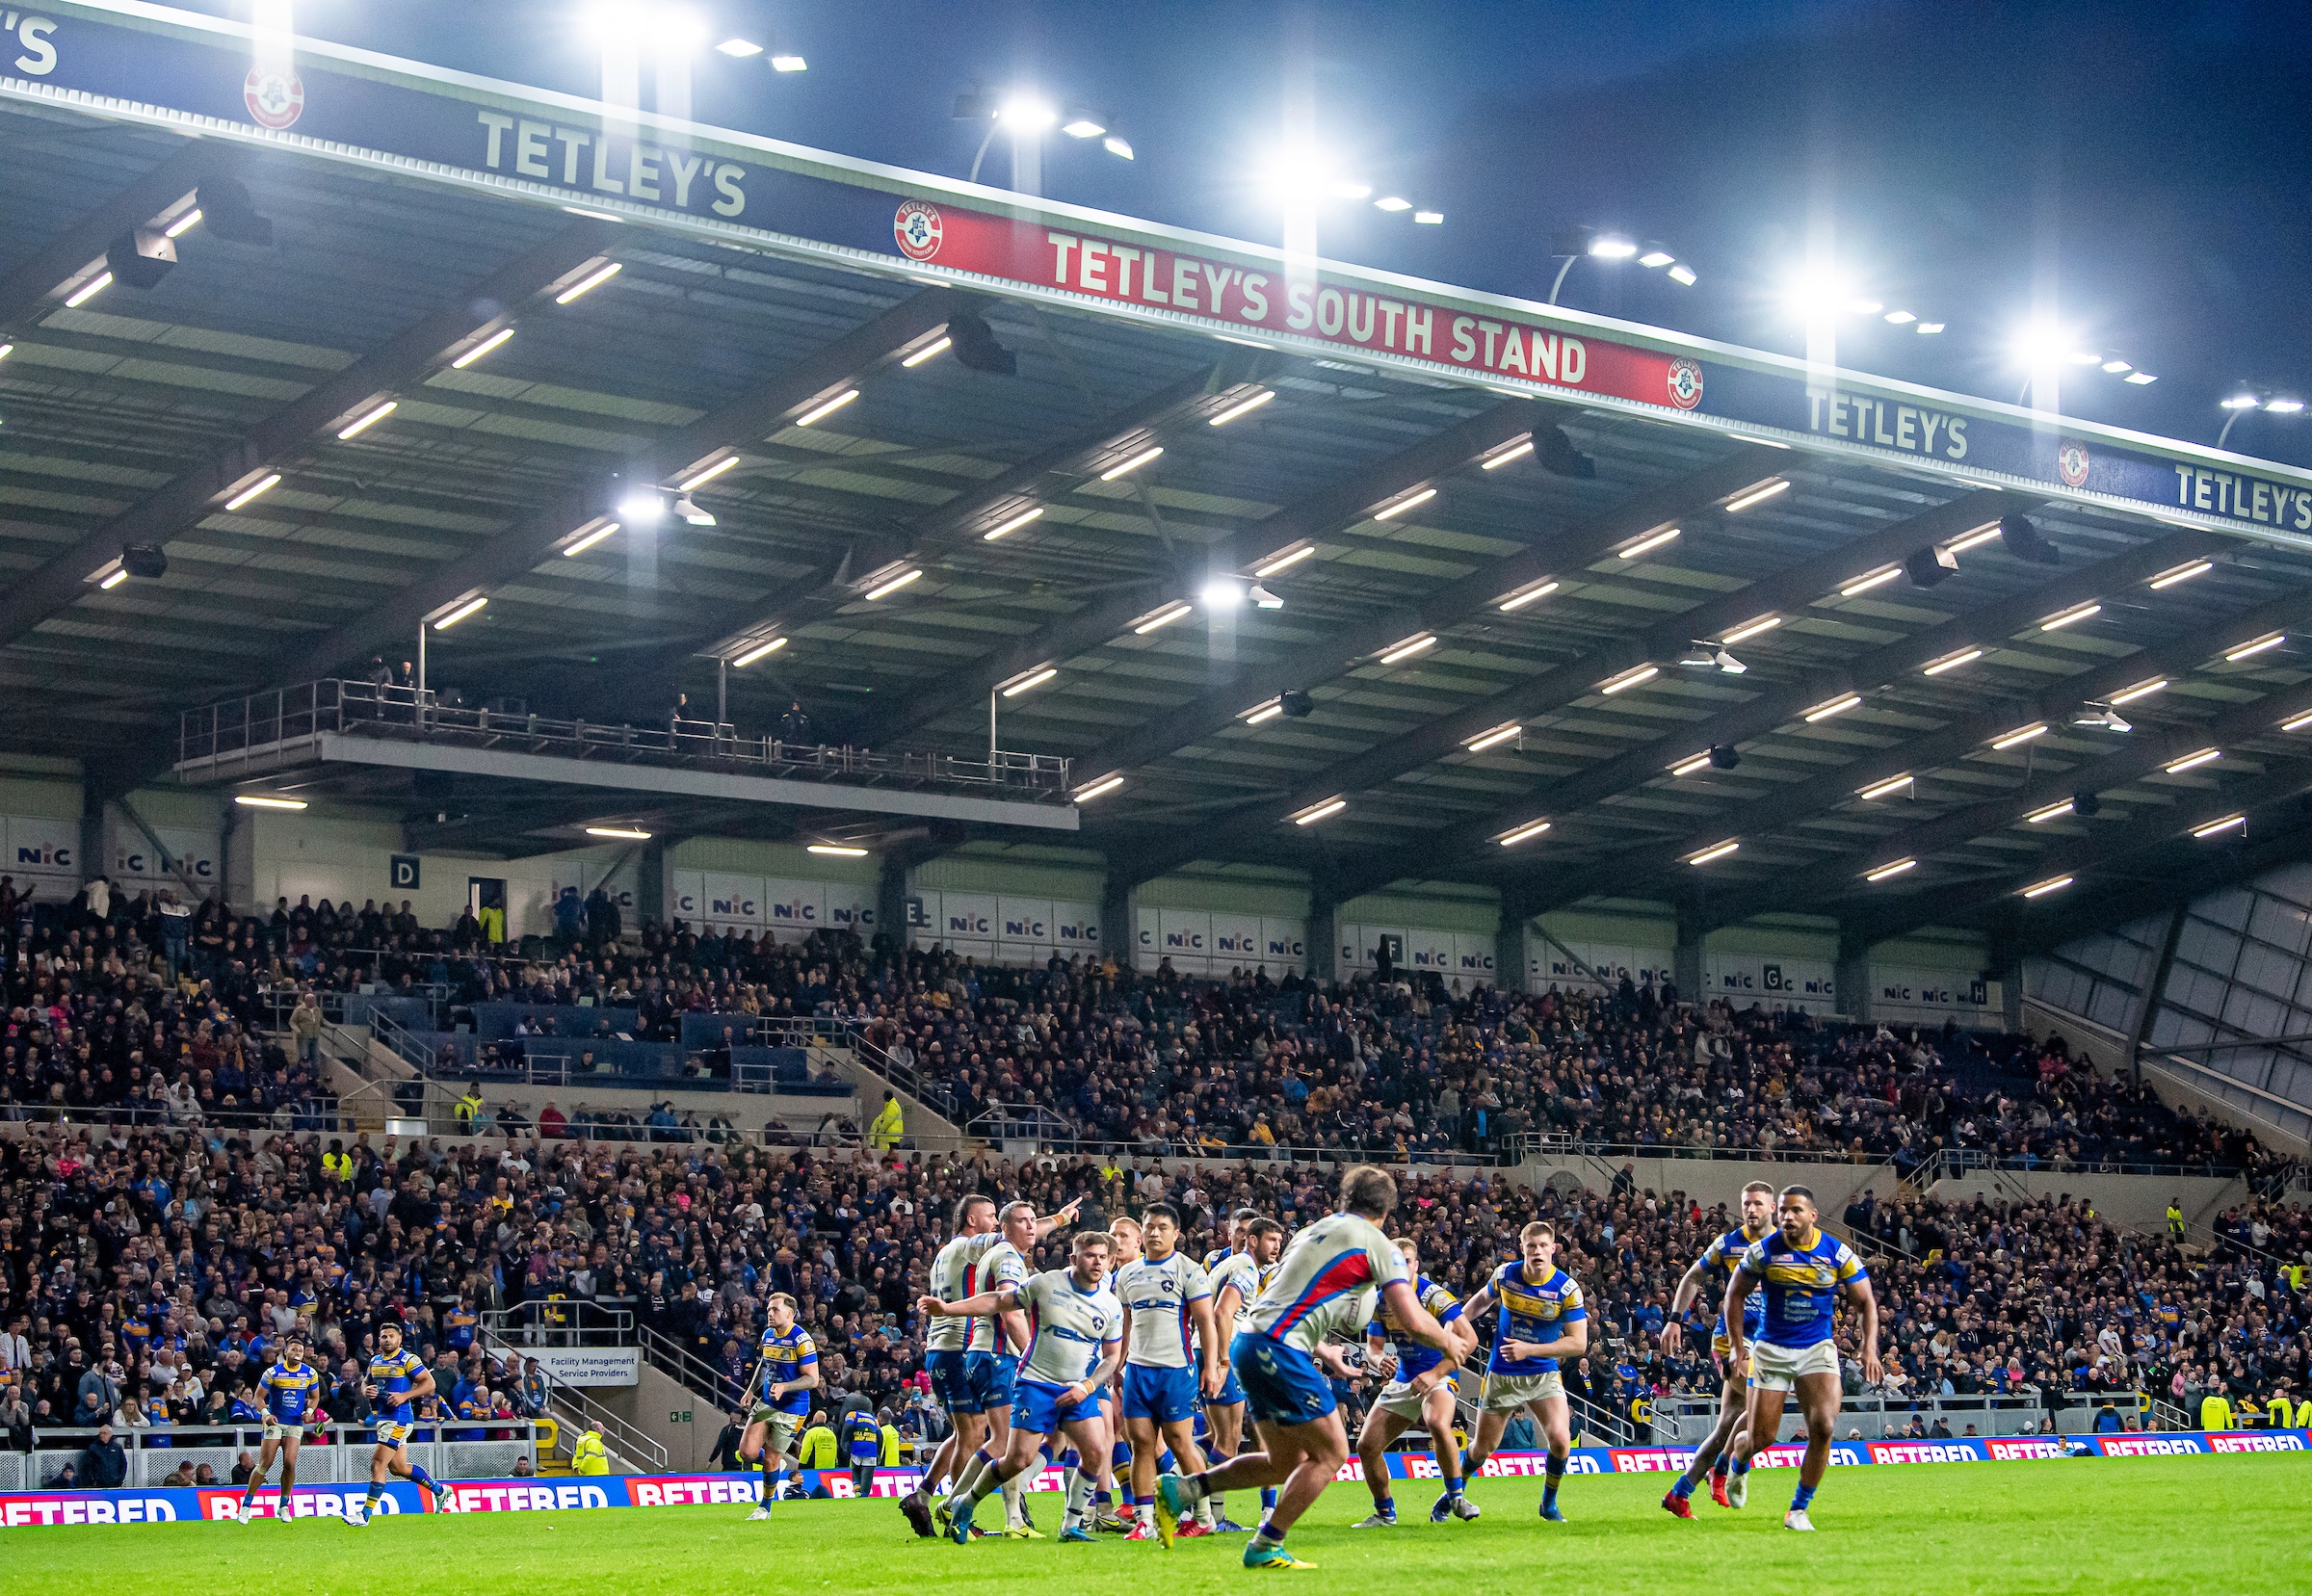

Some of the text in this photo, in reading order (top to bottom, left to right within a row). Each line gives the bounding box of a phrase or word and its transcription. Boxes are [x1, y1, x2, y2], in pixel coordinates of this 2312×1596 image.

[478, 110, 747, 218] TETLEY'S
[901, 201, 937, 222] TETLEY'S
[1047, 231, 1587, 383] TETLEY'S SOUTH STAND
[1804, 387, 1968, 459] TETLEY'S
[2174, 464, 2312, 531] TETLEY'S
[398, 862, 413, 884] D
[906, 903, 917, 923] E
[1389, 941, 1397, 958] F
[1767, 970, 1778, 987] G
[551, 1357, 635, 1367] Facility Management
[591, 1369, 628, 1377] Providers
[1484, 1455, 1601, 1477] BETFED
